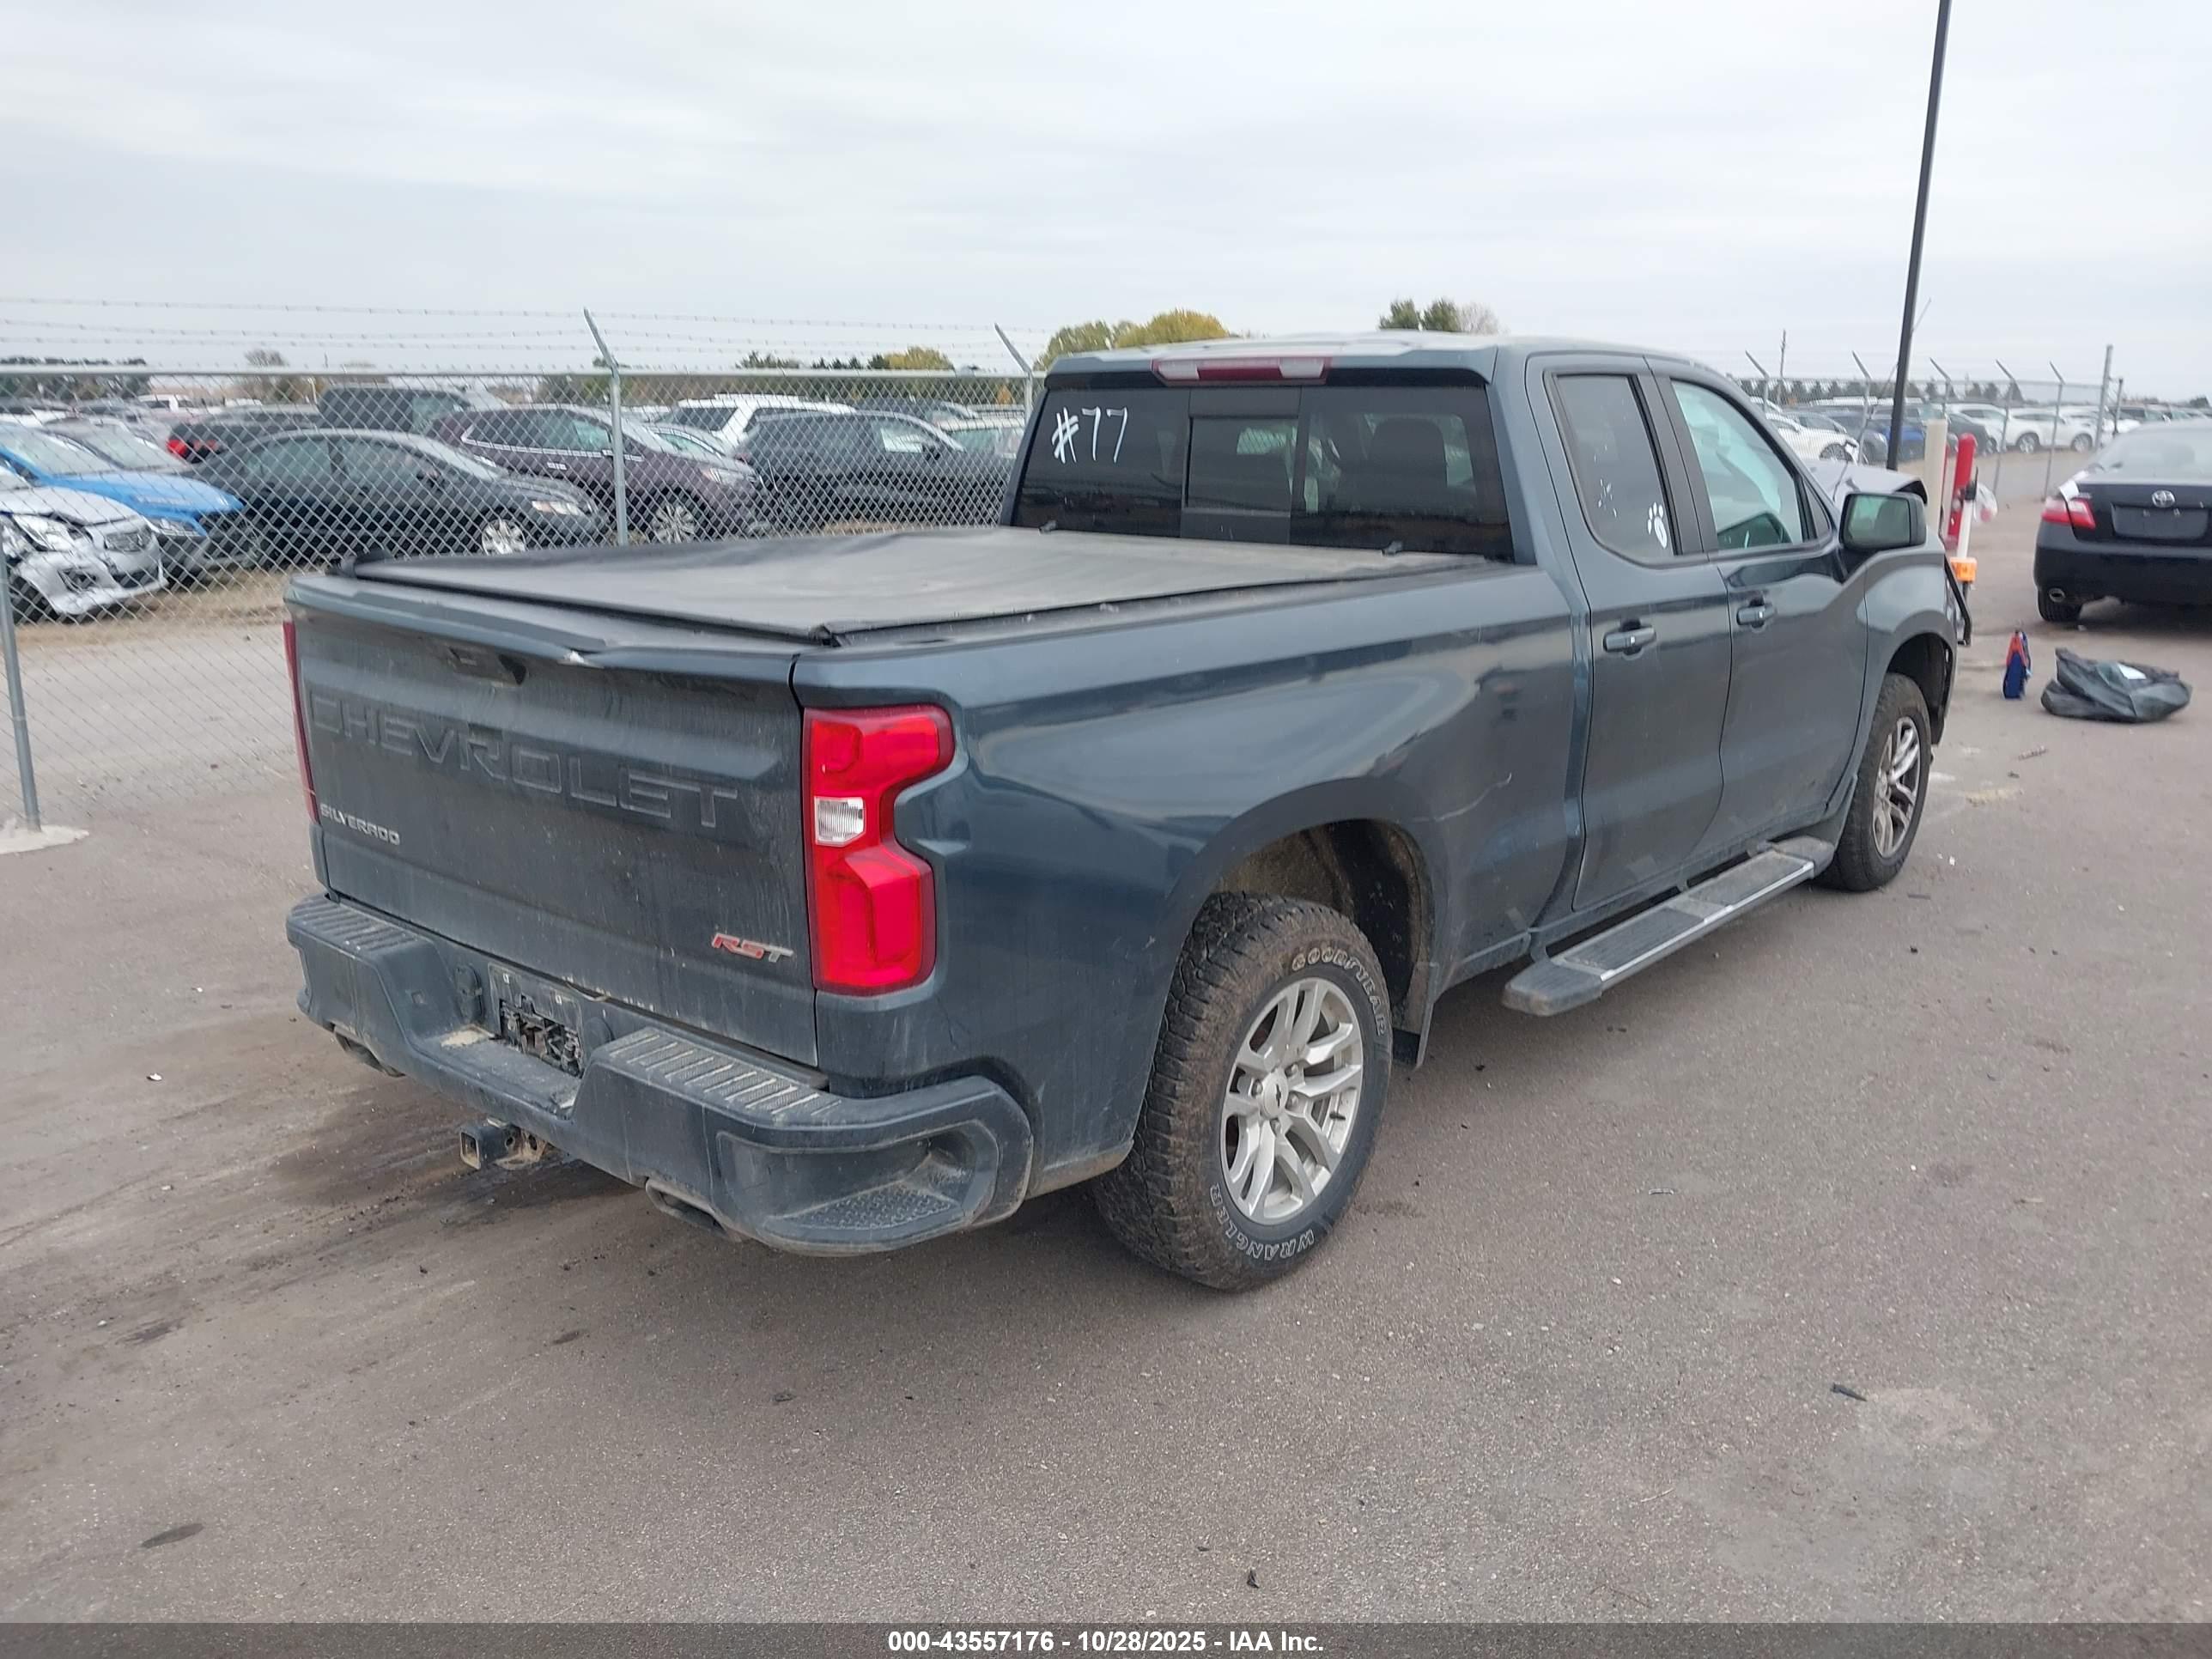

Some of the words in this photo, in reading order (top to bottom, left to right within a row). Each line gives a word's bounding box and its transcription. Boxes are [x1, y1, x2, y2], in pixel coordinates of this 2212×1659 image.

[1051, 406, 1128, 464] #77
[309, 691, 738, 829] CHEVROLET
[319, 802, 401, 846] SILVERADO
[711, 933, 794, 963] RST
[1291, 945, 1388, 1037] GOODYEAR
[1209, 1182, 1316, 1261] WRANGLER
